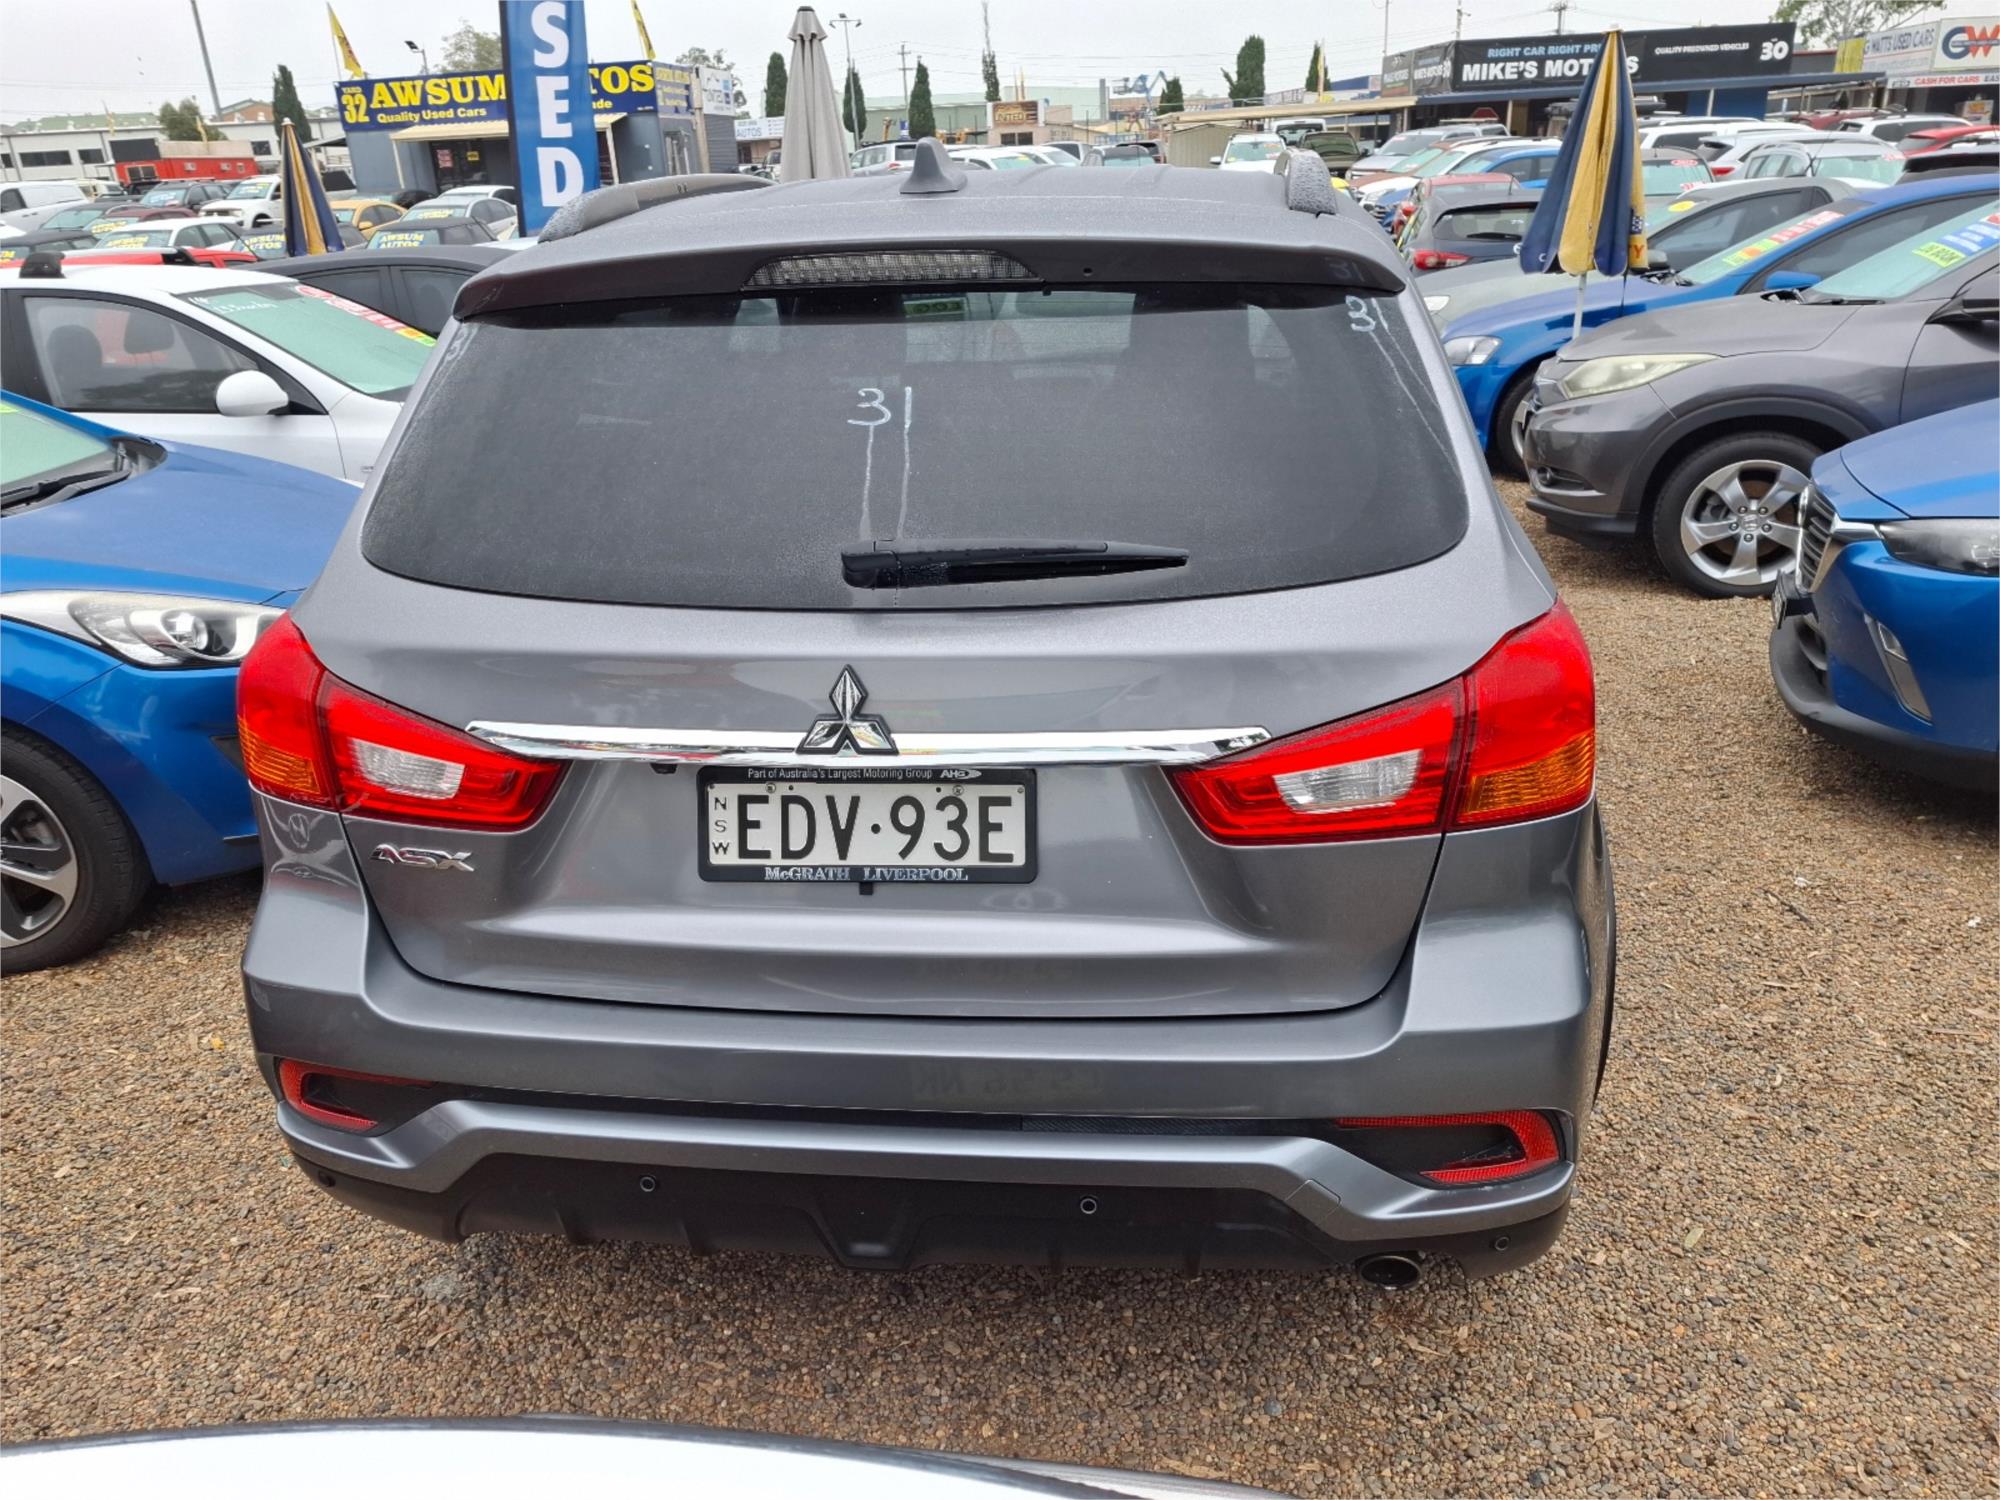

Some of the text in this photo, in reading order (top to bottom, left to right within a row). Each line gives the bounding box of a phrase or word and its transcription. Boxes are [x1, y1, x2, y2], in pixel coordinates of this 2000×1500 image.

[1488, 43, 1602, 58] RIGHT CAR RIGHT PR
[1760, 41, 1789, 61] 30
[1462, 60, 1538, 82] MIKE'S
[1545, 56, 1640, 78] MOTS
[1915, 77, 1937, 86] CASH
[1938, 76, 1956, 85] FOR
[1957, 75, 1980, 84] CARS
[370, 74, 507, 109] AWSUM
[341, 94, 370, 124] 32
[377, 107, 487, 123] Quality Used Cars
[1345, 295, 1388, 332] 31
[847, 386, 912, 428] 31
[747, 768, 766, 779] Part
[768, 768, 777, 779] of
[778, 768, 826, 779] Australia's
[828, 768, 862, 781] Largest
[863, 768, 903, 781] Motoring
[905, 769, 932, 781] Group
[370, 843, 474, 872] ASX
[764, 866, 968, 881] McGRATH LIVERPOOL
